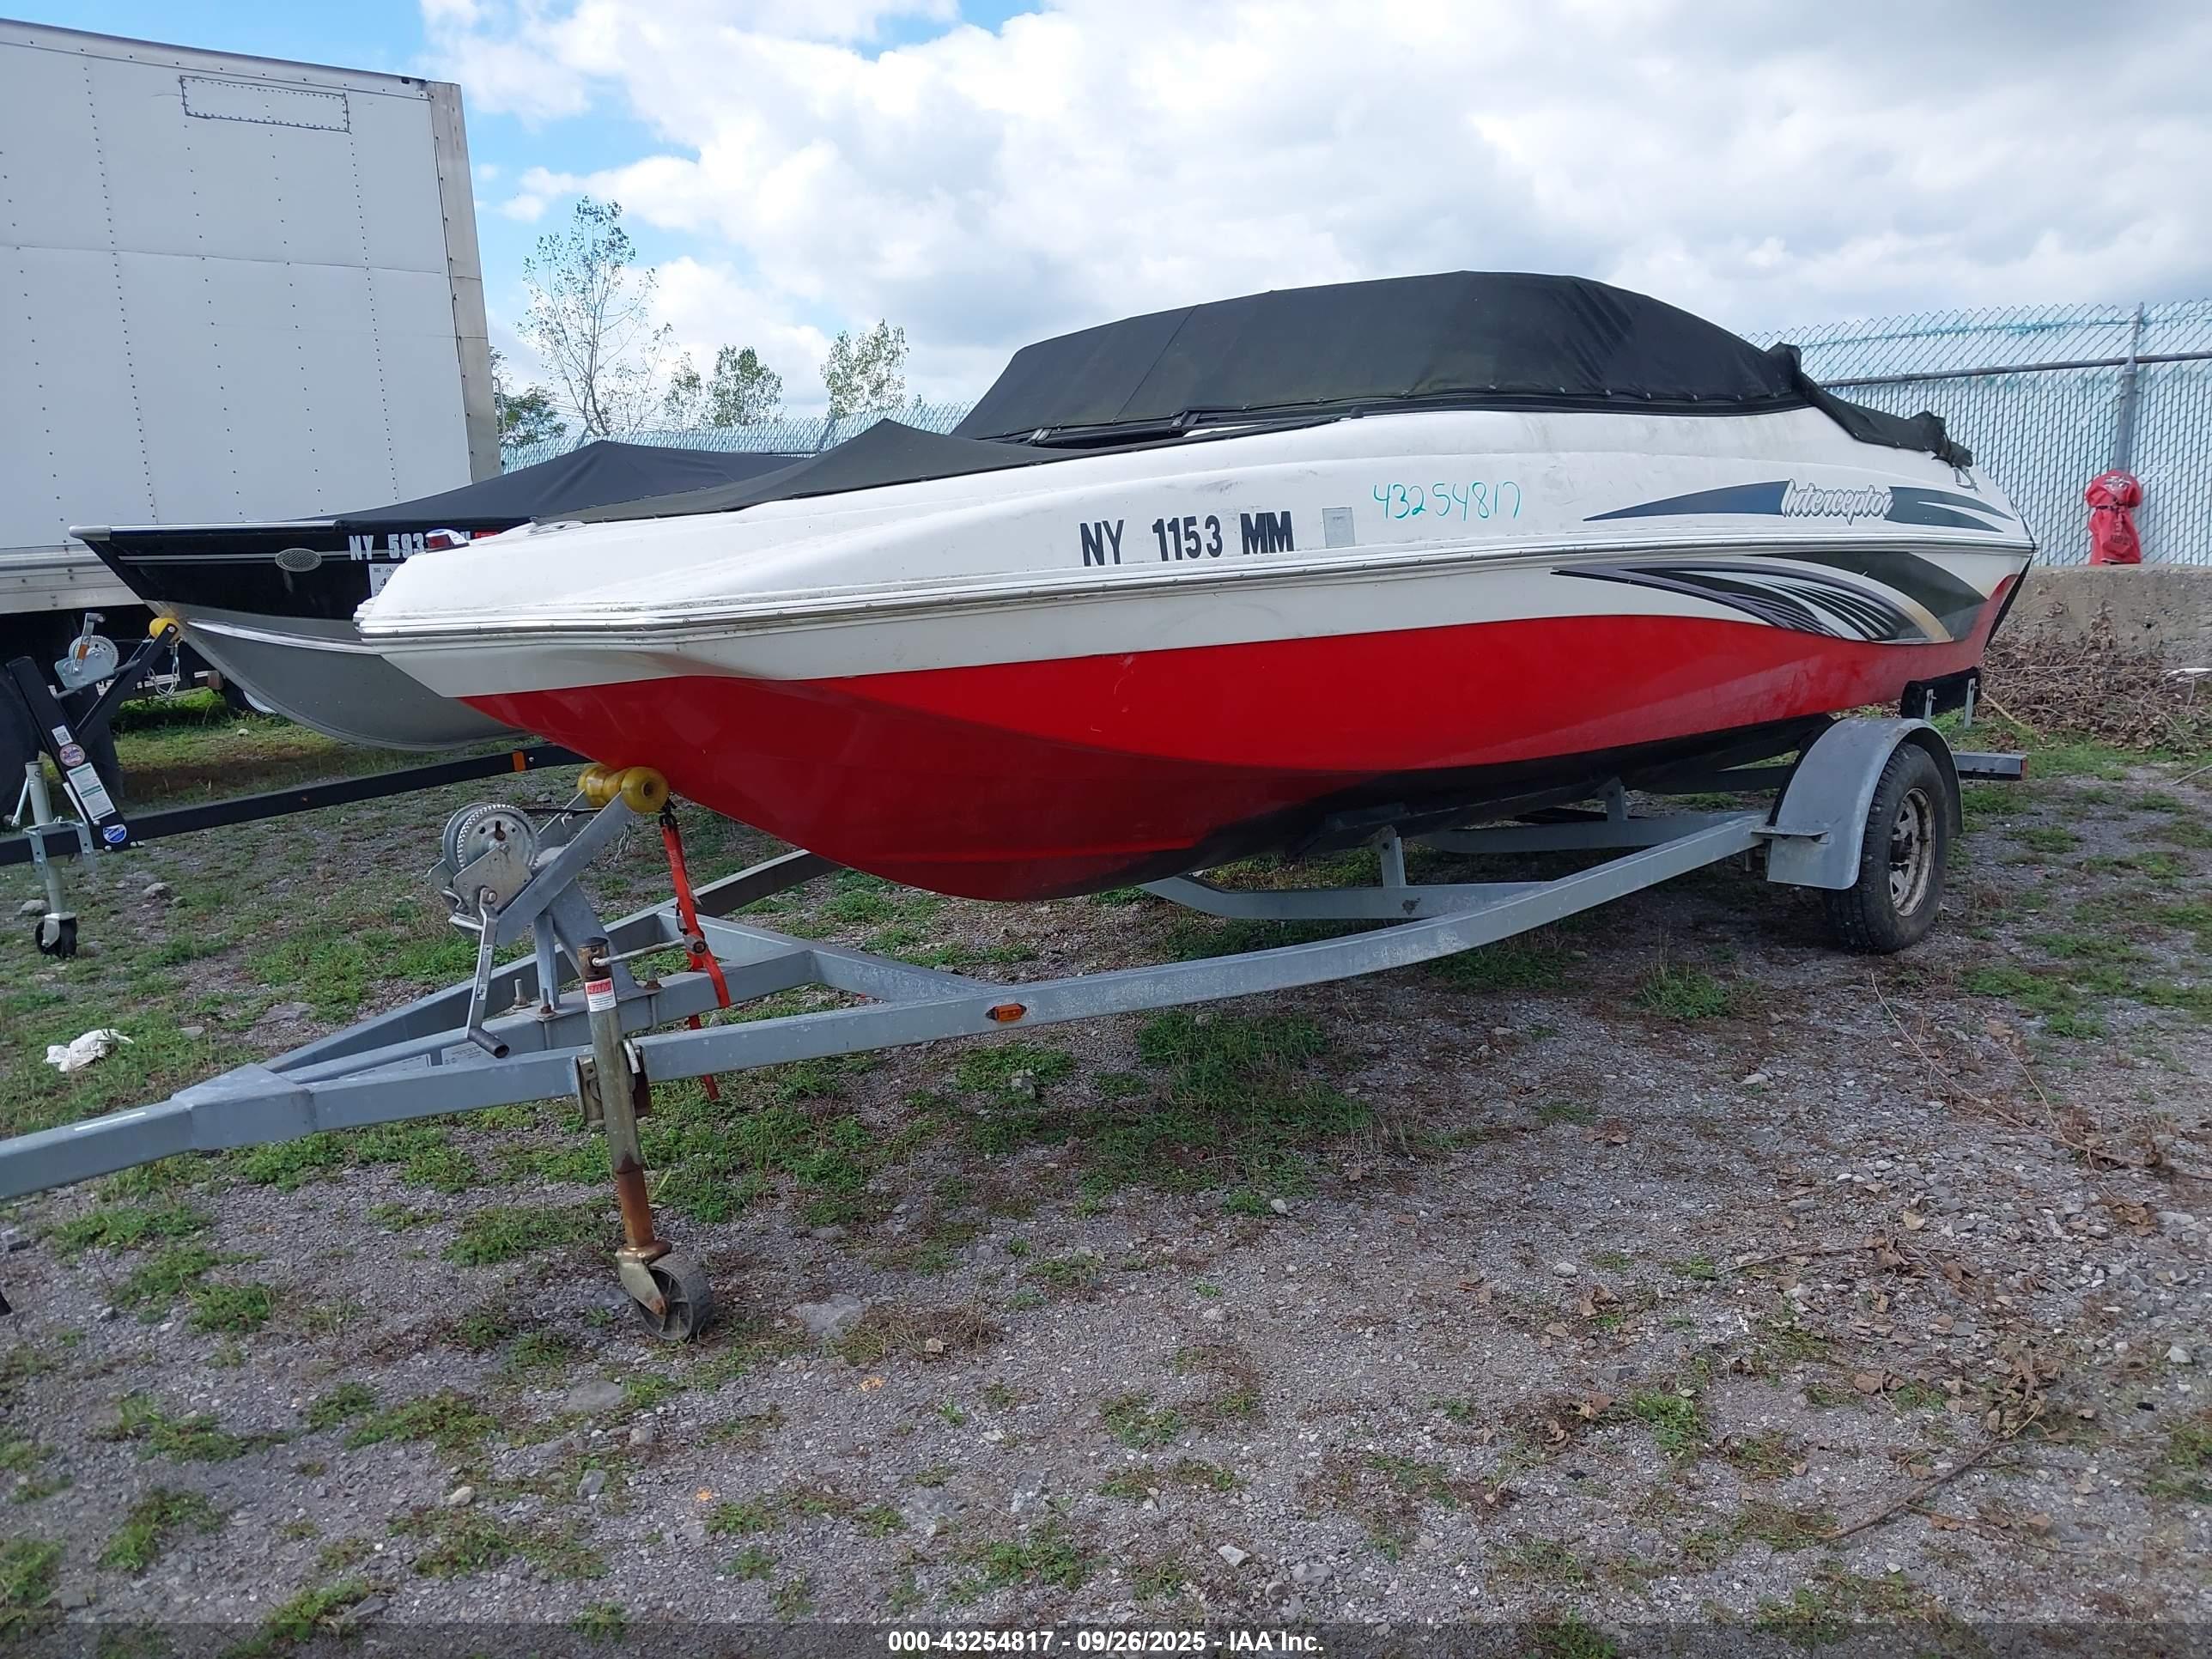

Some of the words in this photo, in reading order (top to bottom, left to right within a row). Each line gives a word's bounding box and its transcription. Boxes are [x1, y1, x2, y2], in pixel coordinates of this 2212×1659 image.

[1781, 478, 1894, 526] Interceptor
[349, 535, 374, 561] NY
[387, 532, 428, 558] 593
[1079, 520, 1124, 567] NY
[1152, 515, 1224, 562] 1153
[1239, 511, 1295, 555] MM
